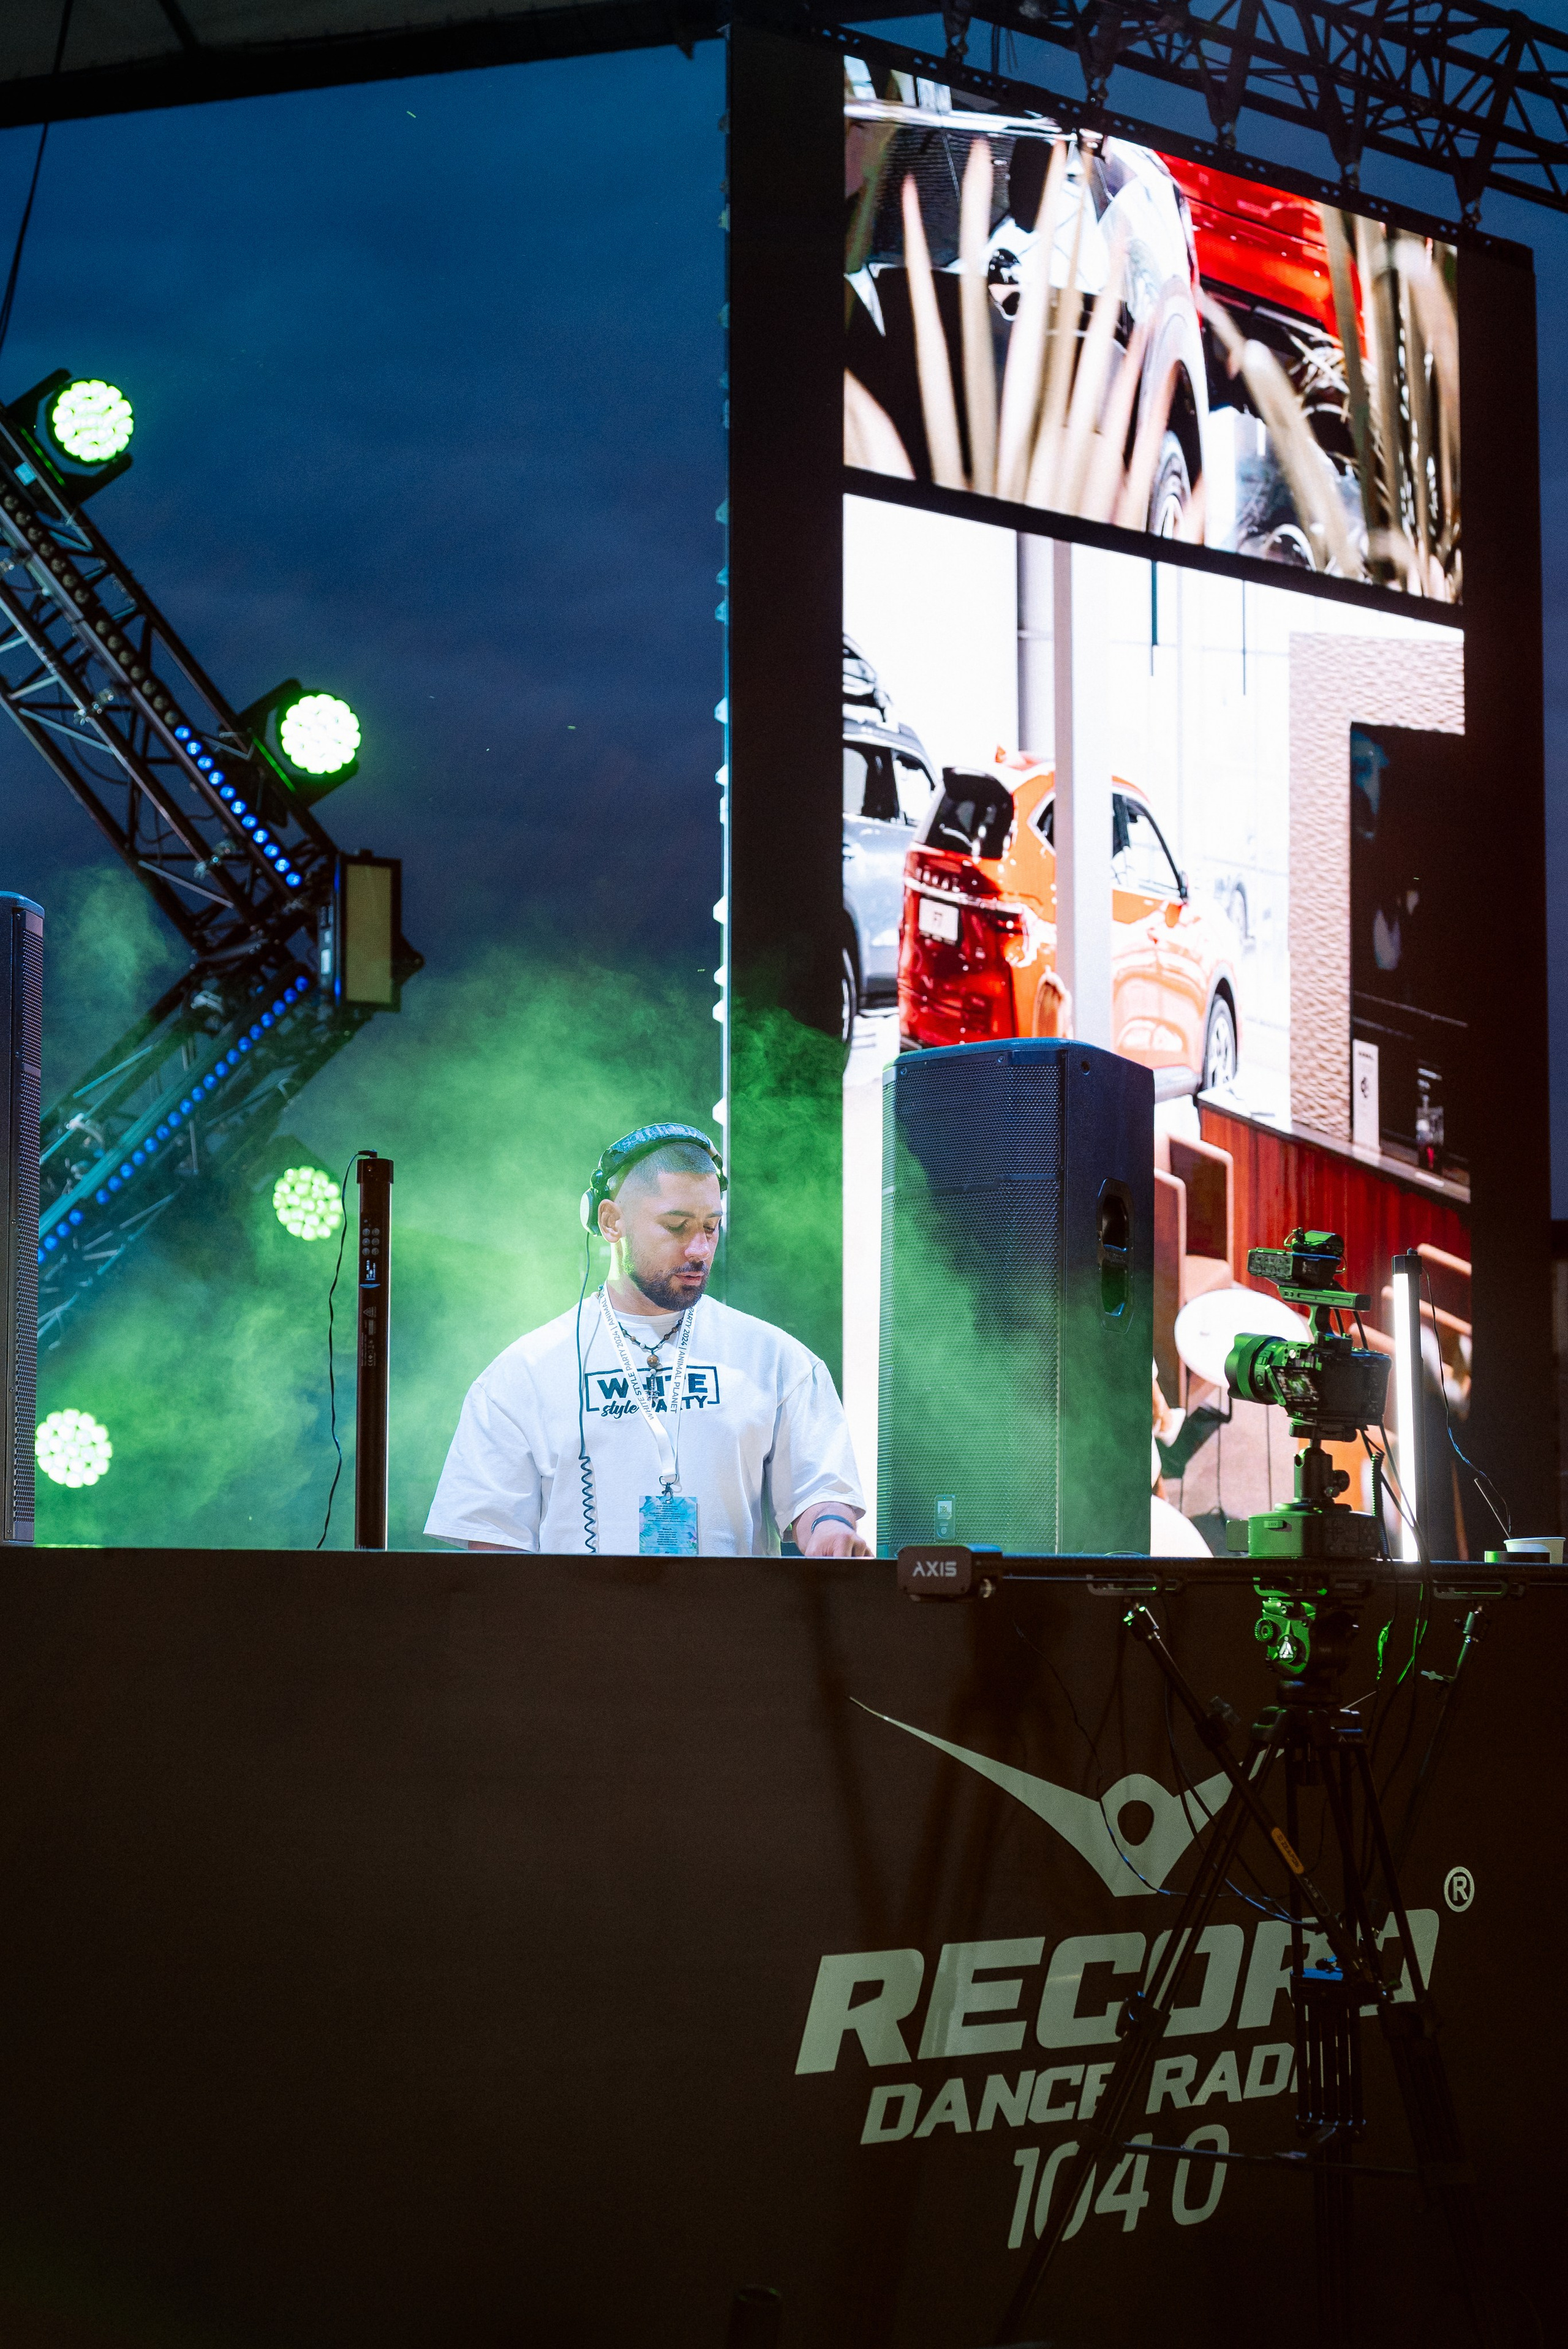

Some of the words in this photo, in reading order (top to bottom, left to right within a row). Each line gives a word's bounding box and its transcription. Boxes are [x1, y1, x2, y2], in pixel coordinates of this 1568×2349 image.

[601, 1297, 615, 1326] ANIMAL
[685, 1306, 695, 1329] PARTY
[612, 1330, 624, 1348] 2024
[680, 1329, 690, 1346] 2024
[618, 1349, 633, 1371] PARTY
[674, 1351, 686, 1379] ANIMAL
[597, 1373, 708, 1399] WIE
[628, 1371, 642, 1396] STYLE
[601, 1400, 639, 1419] style
[650, 1396, 708, 1413] ATY
[638, 1397, 654, 1420] WHITE
[671, 1382, 681, 1414] PLANET
[913, 1561, 957, 1577] AXIS
[1145, 2042, 1298, 2114] RAD
